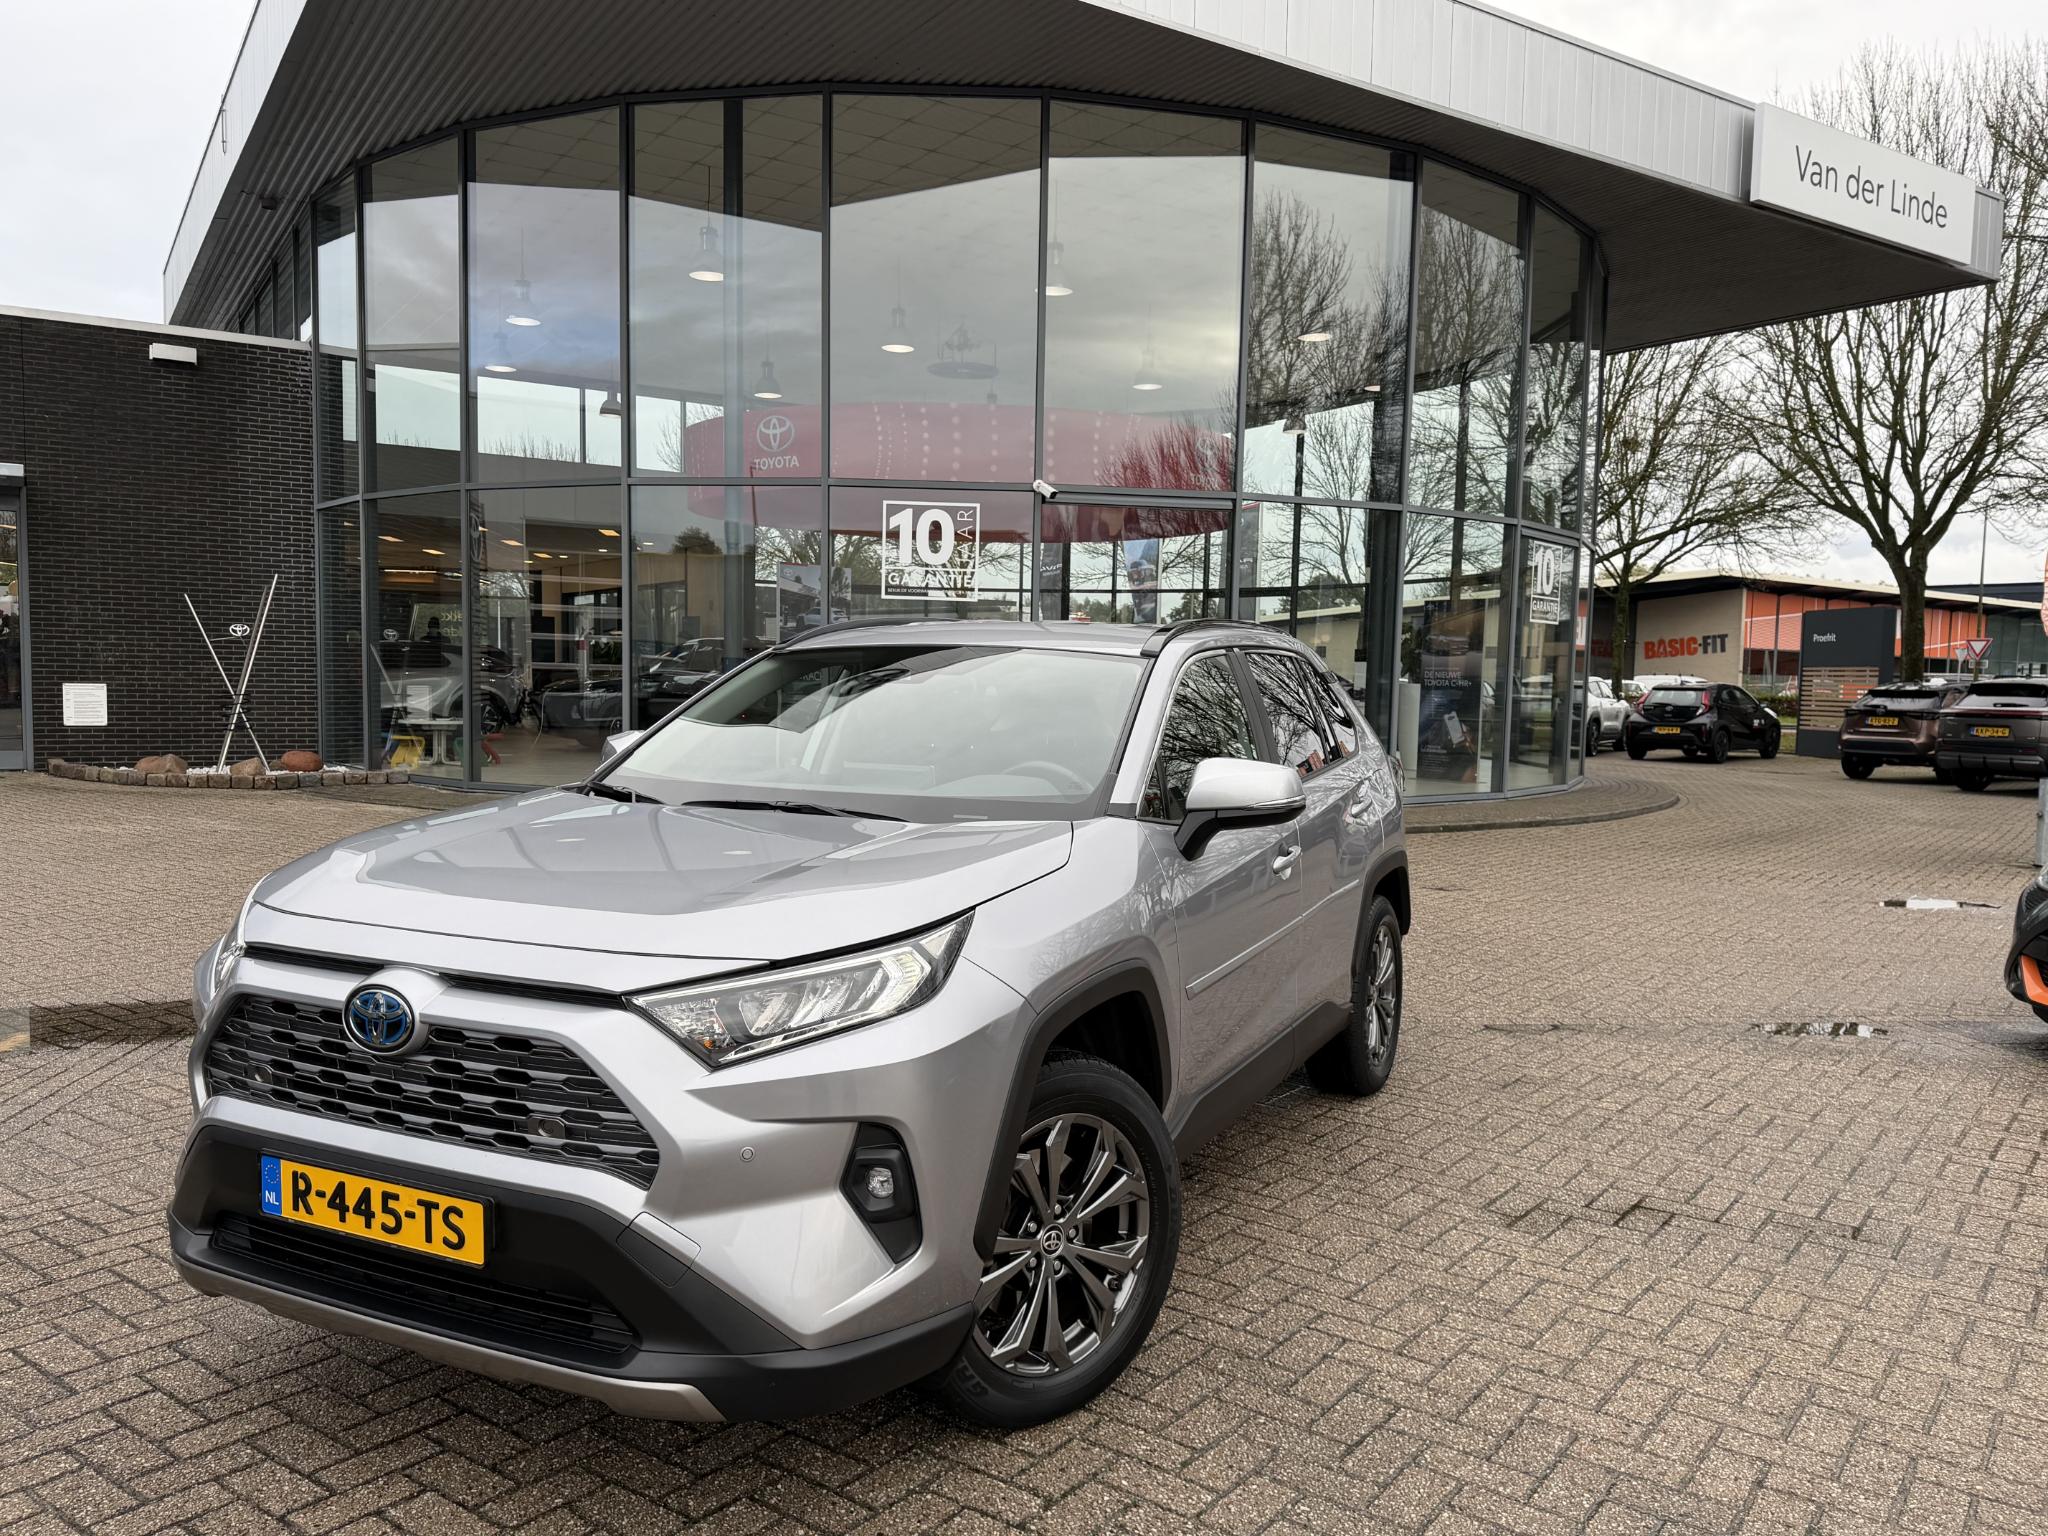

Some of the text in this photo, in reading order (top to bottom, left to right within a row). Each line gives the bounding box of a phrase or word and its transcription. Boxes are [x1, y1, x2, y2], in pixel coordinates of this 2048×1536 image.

[1795, 145, 1948, 229] Van der Linde
[754, 456, 800, 471] TOYOTA
[889, 508, 955, 566] 10
[956, 509, 974, 569] JAAR
[888, 573, 973, 588] GARANTIE
[1535, 545, 1555, 595] 10
[1532, 600, 1559, 613] GARANTIE
[1813, 633, 1837, 643] Proefrit
[1424, 679, 1450, 687] TOYOTA
[264, 1169, 467, 1252] NL R-445-TS
